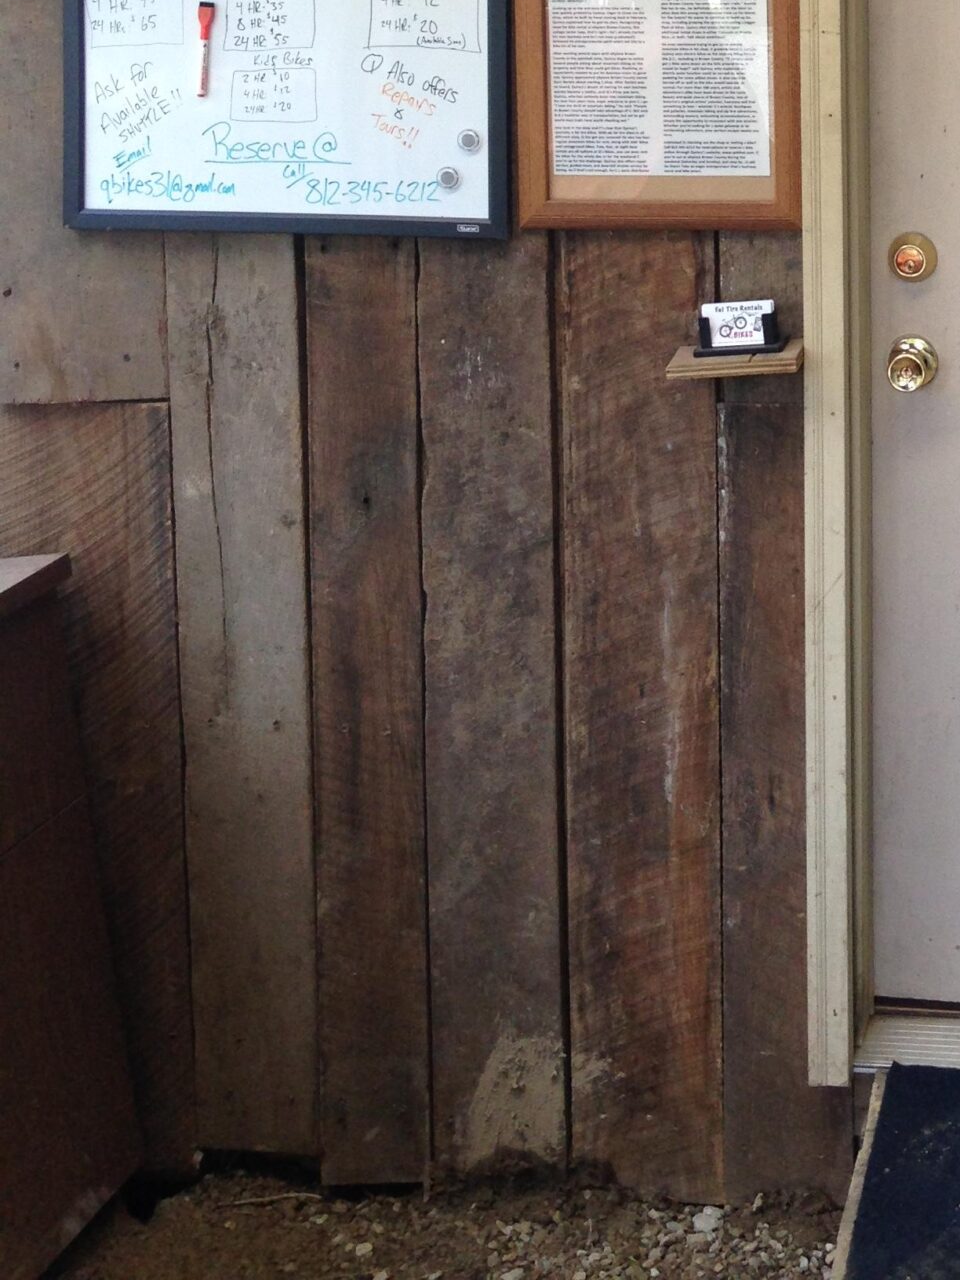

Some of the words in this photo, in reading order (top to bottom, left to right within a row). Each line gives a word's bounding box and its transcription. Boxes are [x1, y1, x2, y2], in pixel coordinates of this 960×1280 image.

[94, 74, 126, 105] Ask
[382, 82, 437, 116] Repairs
[386, 60, 415, 86] Also
[422, 75, 459, 104] offers
[100, 85, 161, 134] Available
[112, 135, 152, 169] Email
[202, 121, 307, 160] Reserve
[740, 303, 763, 311] Rentals
